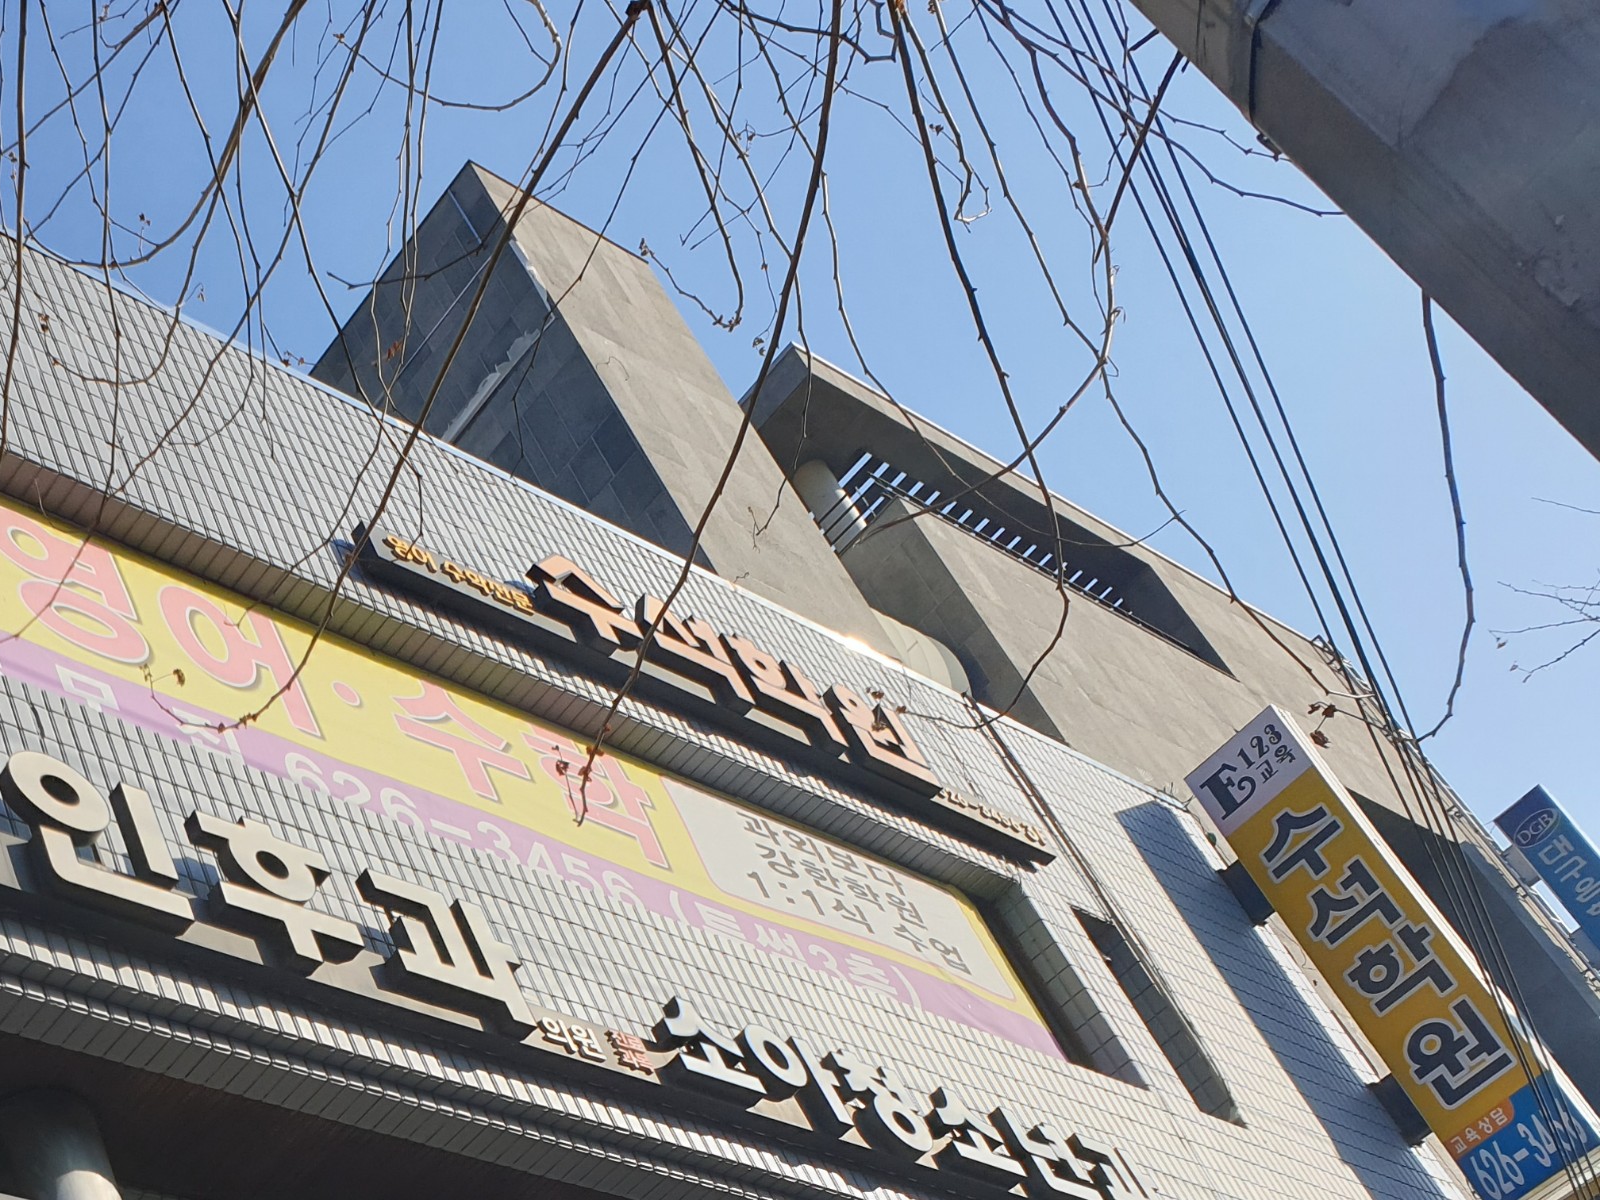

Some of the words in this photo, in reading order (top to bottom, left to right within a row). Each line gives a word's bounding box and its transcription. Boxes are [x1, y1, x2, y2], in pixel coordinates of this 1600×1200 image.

[386, 533, 438, 572] 영어
[530, 554, 942, 790] 수석학원
[1236, 723, 1283, 770] 123
[1254, 744, 1297, 785] 교육
[284, 751, 647, 910] 626-3456
[736, 811, 905, 897] 과외보다
[1516, 812, 1552, 845] DGB
[755, 843, 926, 929] 강한학원
[1537, 833, 1600, 917] 대구은
[893, 923, 973, 976] 수업
[1259, 802, 1519, 1111] 수석학원
[542, 1016, 608, 1062] 의원
[1450, 1107, 1508, 1154] 교육상담
